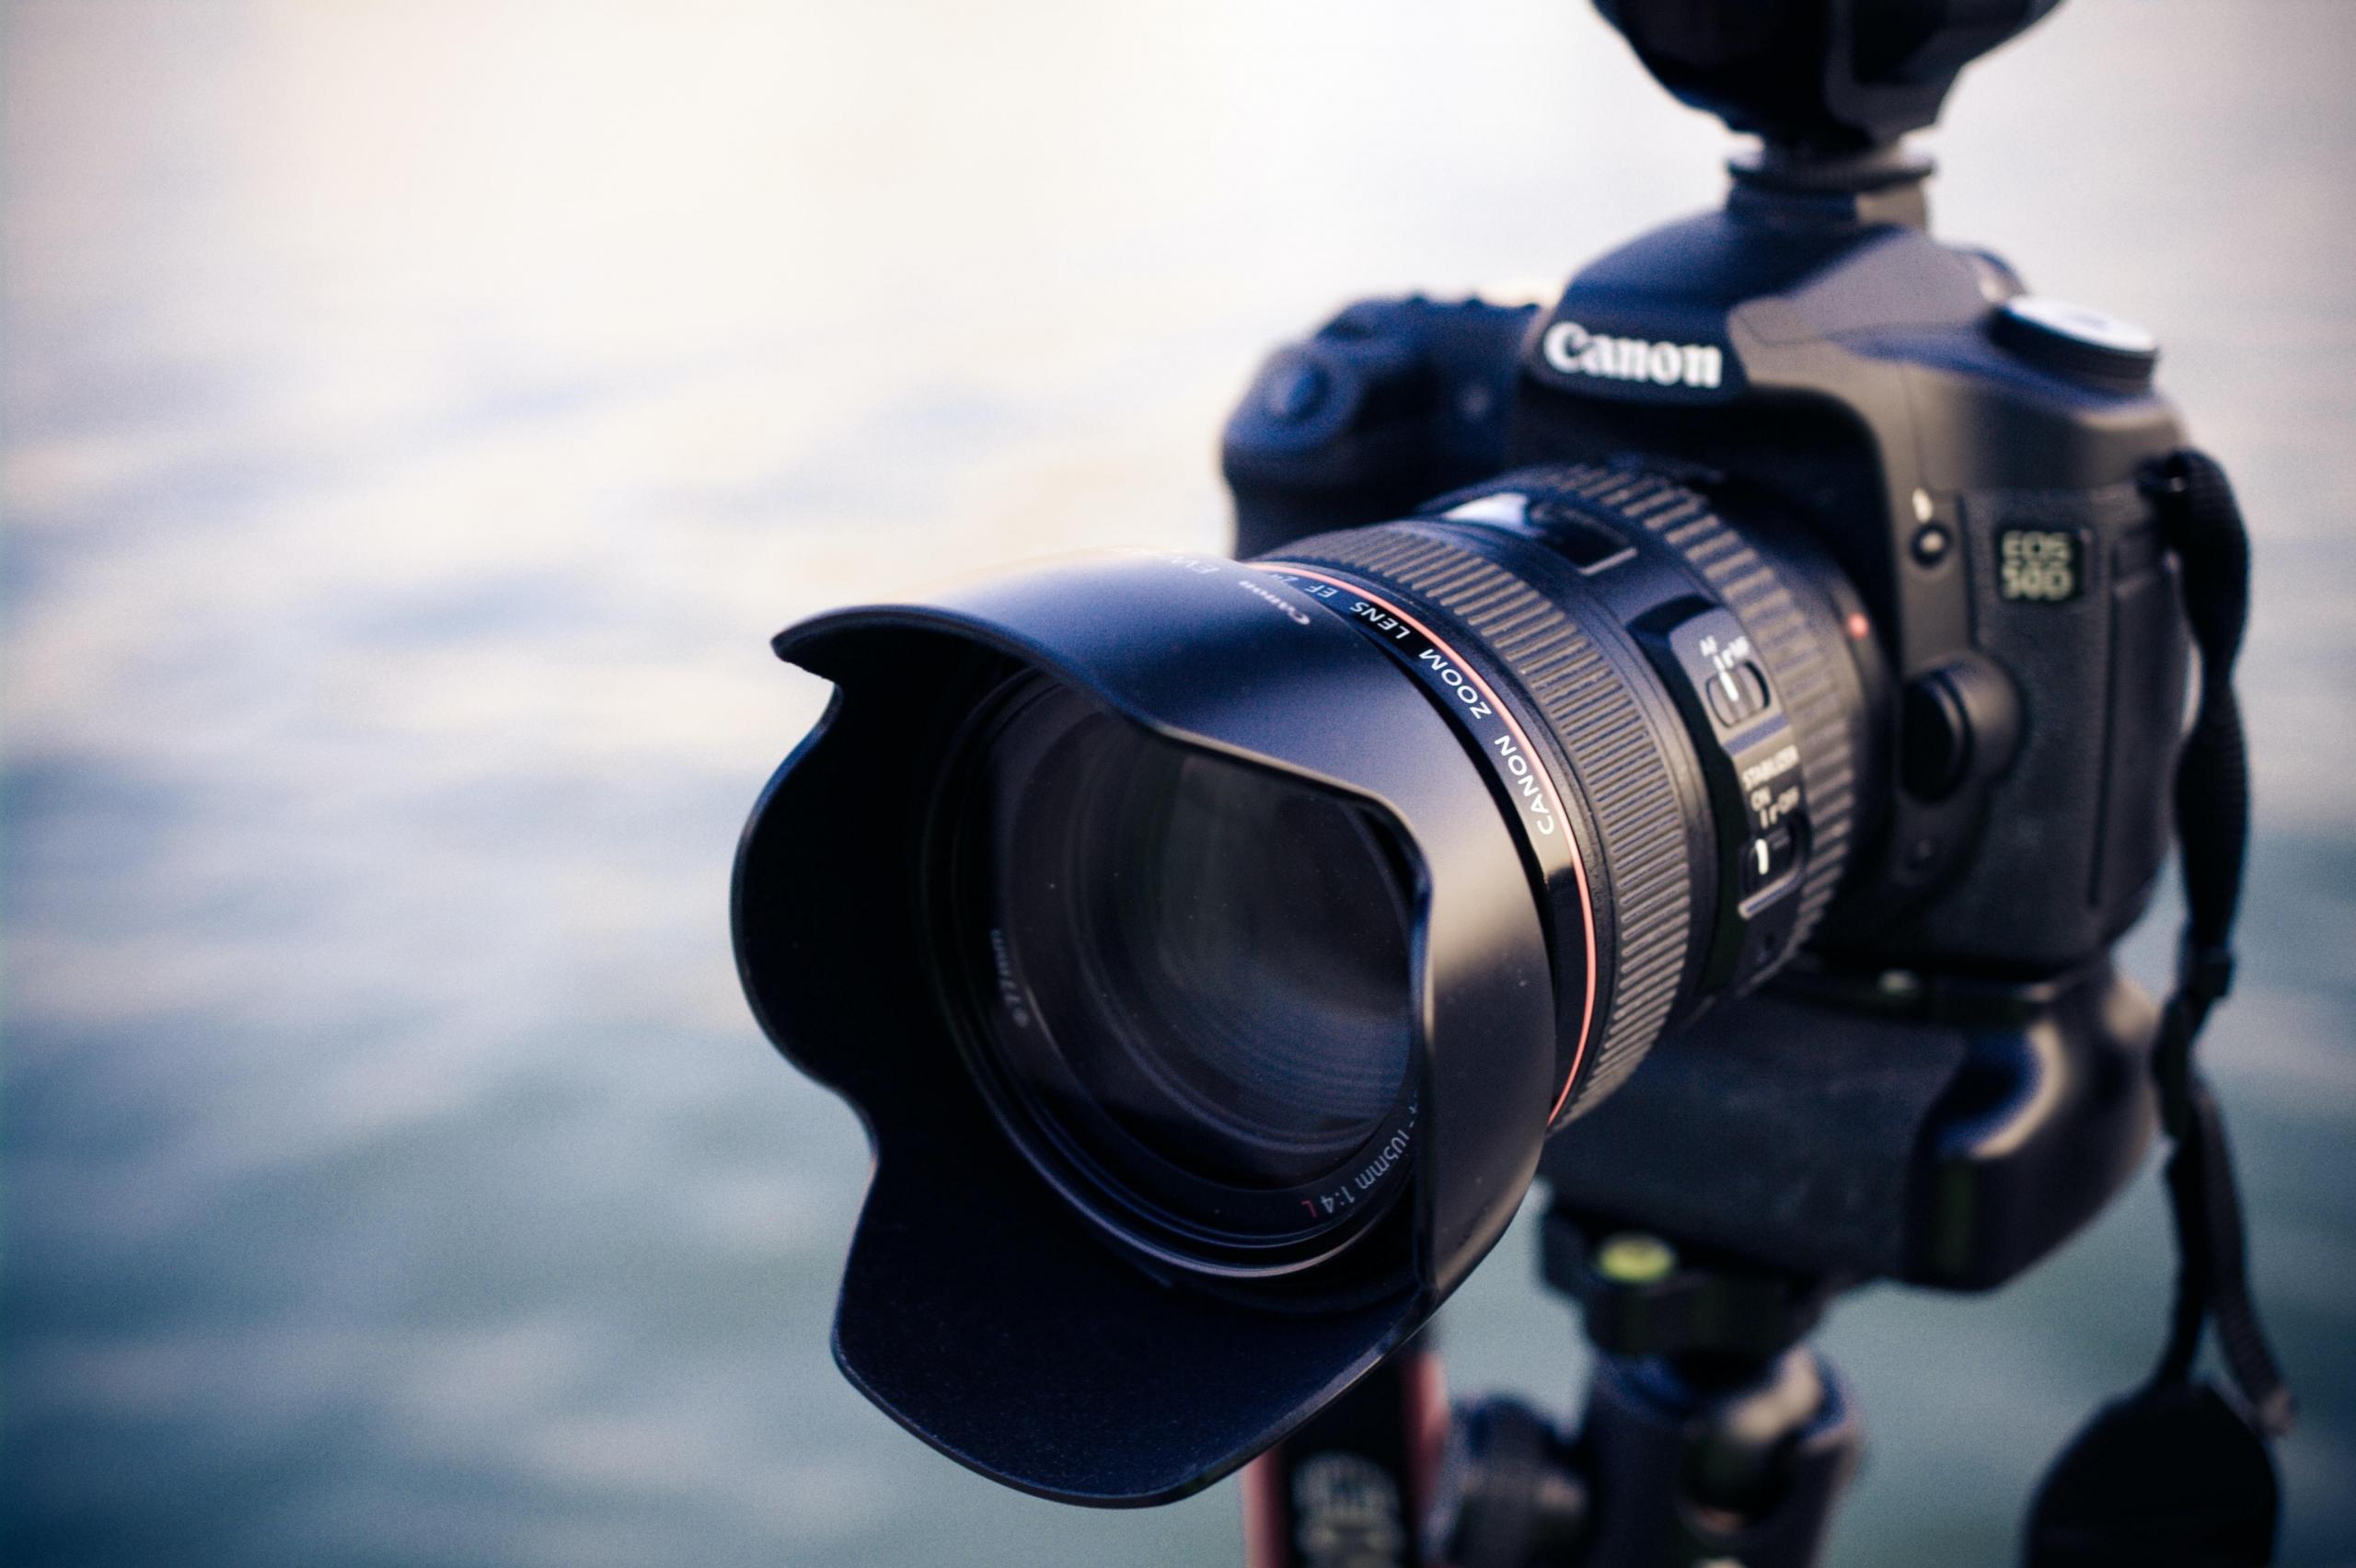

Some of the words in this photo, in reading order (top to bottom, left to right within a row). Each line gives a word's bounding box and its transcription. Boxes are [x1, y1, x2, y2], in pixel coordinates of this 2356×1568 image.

[1543, 321, 1723, 389] Canon
[2002, 530, 2072, 559] EOS
[1304, 584, 1340, 598] EF
[1349, 601, 1411, 640] LENS
[1418, 647, 1492, 720] ZOOM
[1494, 735, 1554, 836] CANON
[1300, 1200, 1317, 1218] L
[1321, 1186, 1356, 1214] 1:4
